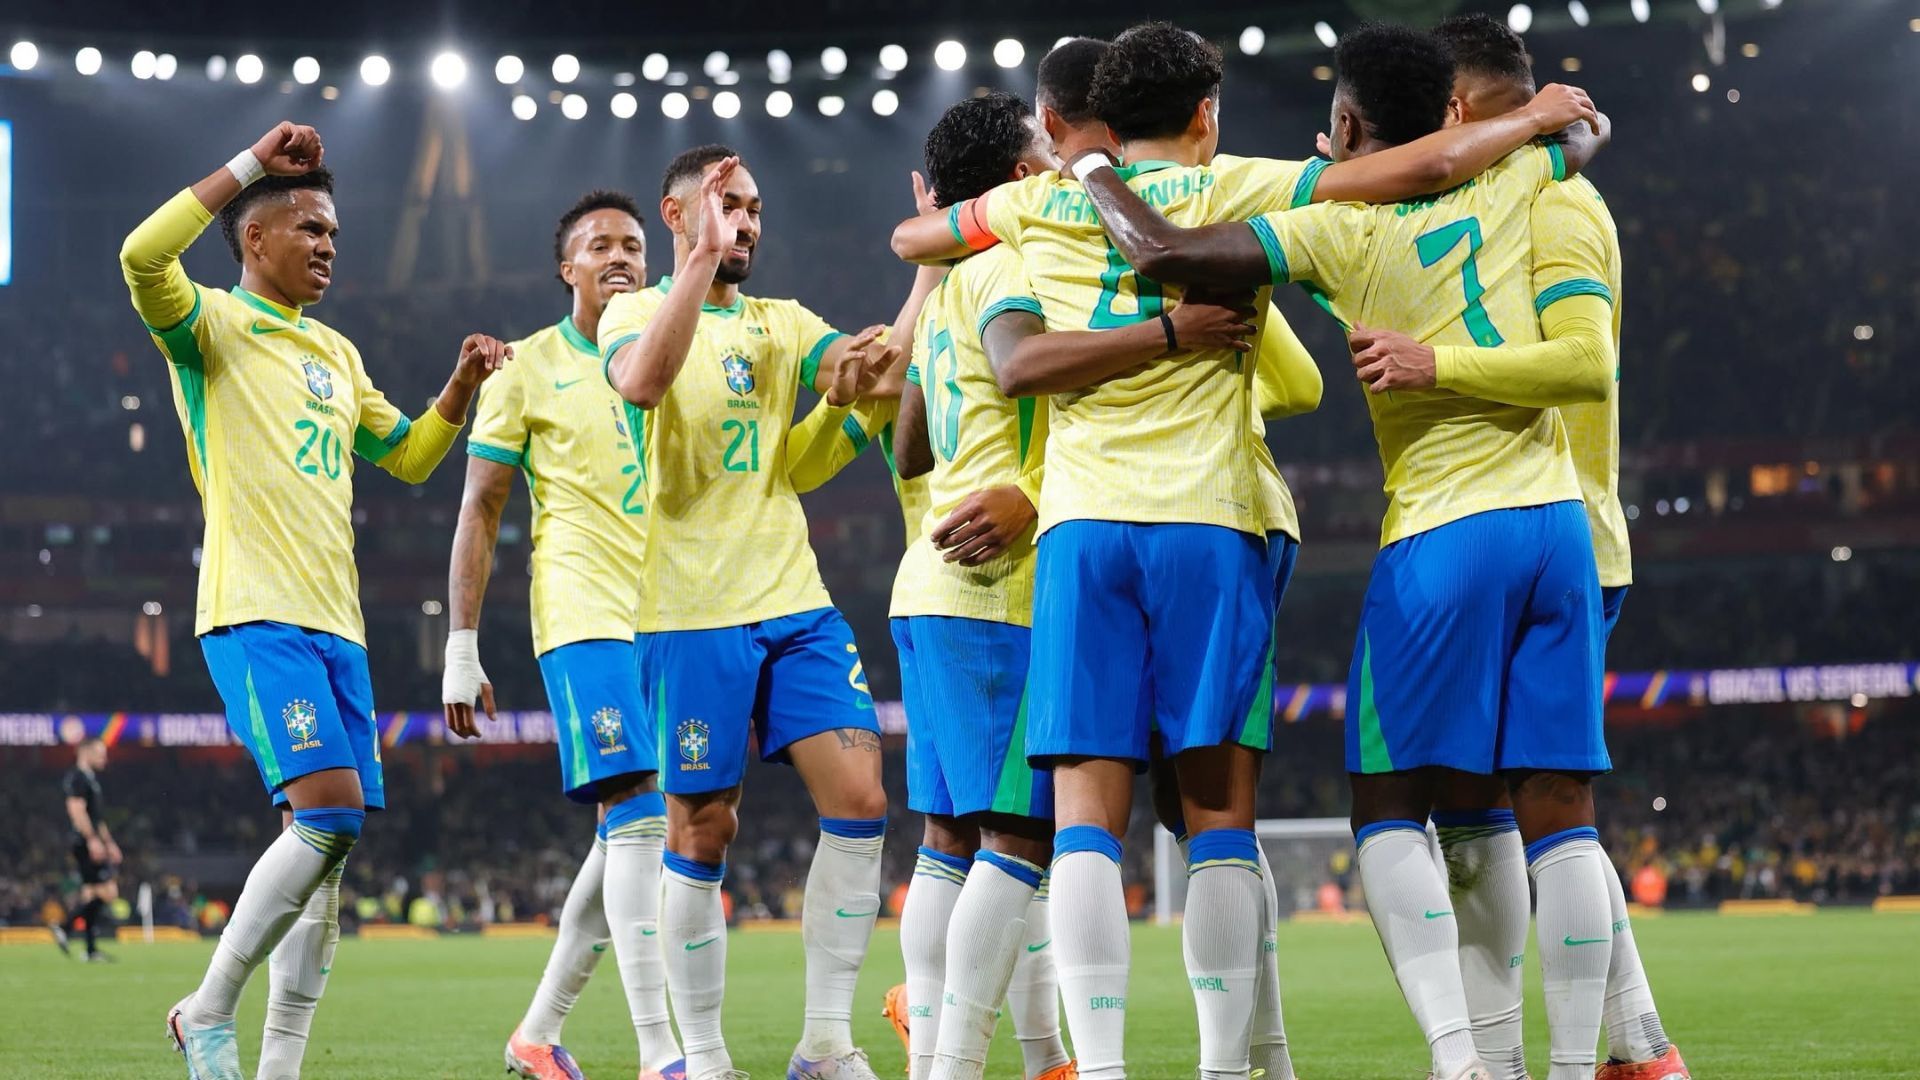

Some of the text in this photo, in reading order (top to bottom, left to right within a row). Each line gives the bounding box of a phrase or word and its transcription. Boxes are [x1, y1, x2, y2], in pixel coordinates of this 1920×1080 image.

[1415, 216, 1505, 348] 7
[306, 400, 335, 416] BRASIL
[727, 399, 760, 409] BRASIL
[294, 419, 341, 480] 20
[721, 418, 759, 472] 21
[1709, 663, 1911, 704] BRAZIL VS SENEGAL
[292, 740, 323, 752] BRASIL
[680, 762, 711, 771] BRASIL
